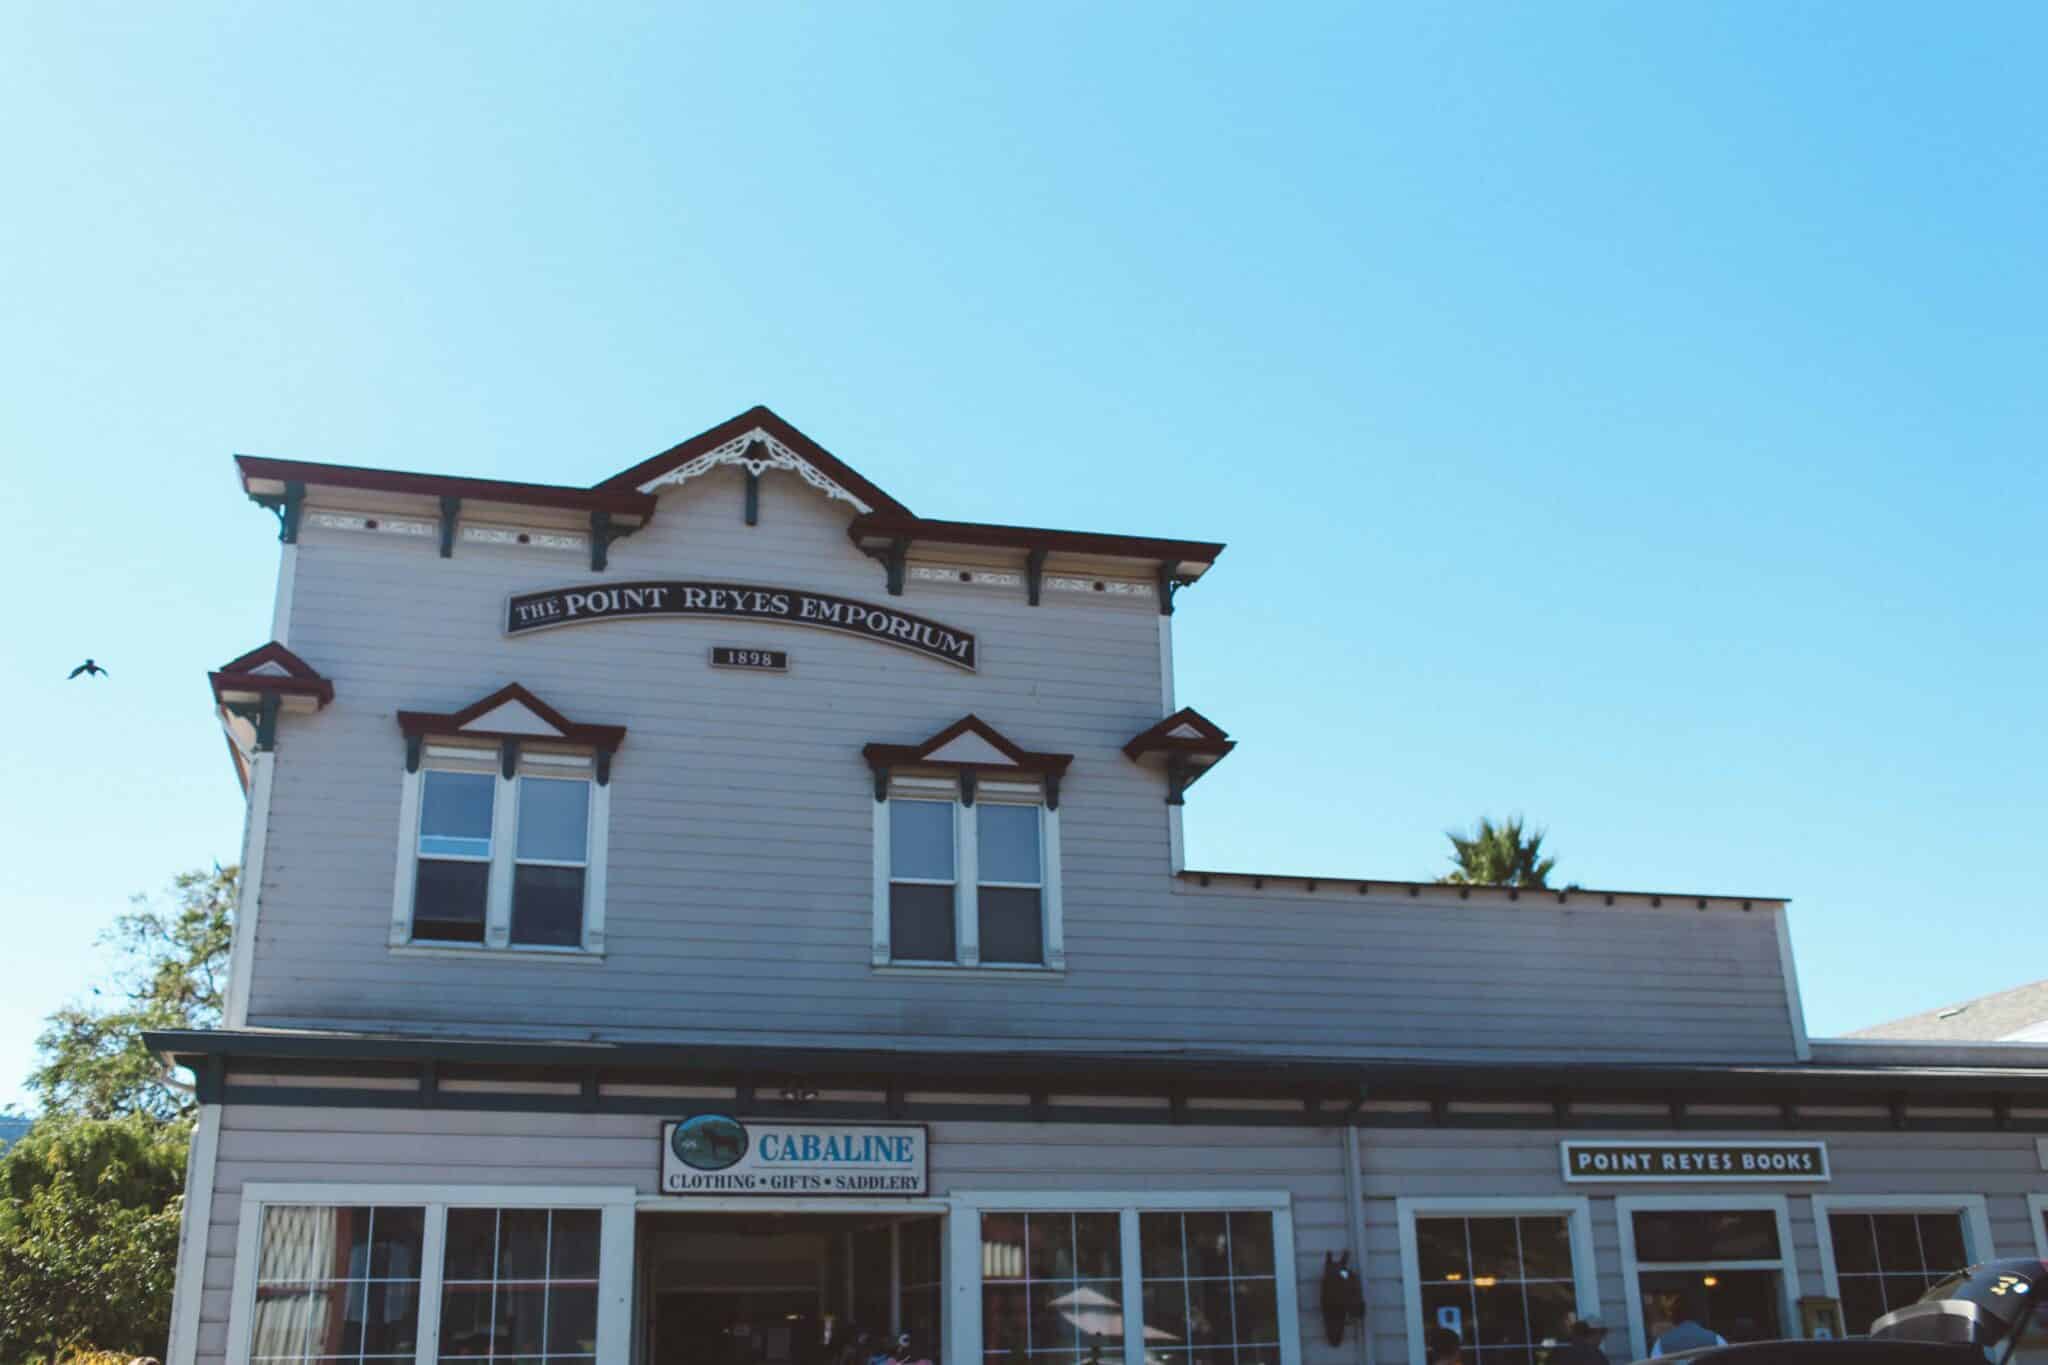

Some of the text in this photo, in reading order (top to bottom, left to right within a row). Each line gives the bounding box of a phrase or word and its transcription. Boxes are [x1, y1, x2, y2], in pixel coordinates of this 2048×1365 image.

[515, 587, 969, 658] THE POINT REYES EMPORIUM
[727, 650, 773, 667] 1898
[759, 1134, 914, 1163] CABALINE
[1578, 1153, 1813, 1170] POINT REYES BOOKS
[669, 1174, 920, 1191] CLOTHING GIFTS SADDLERY
